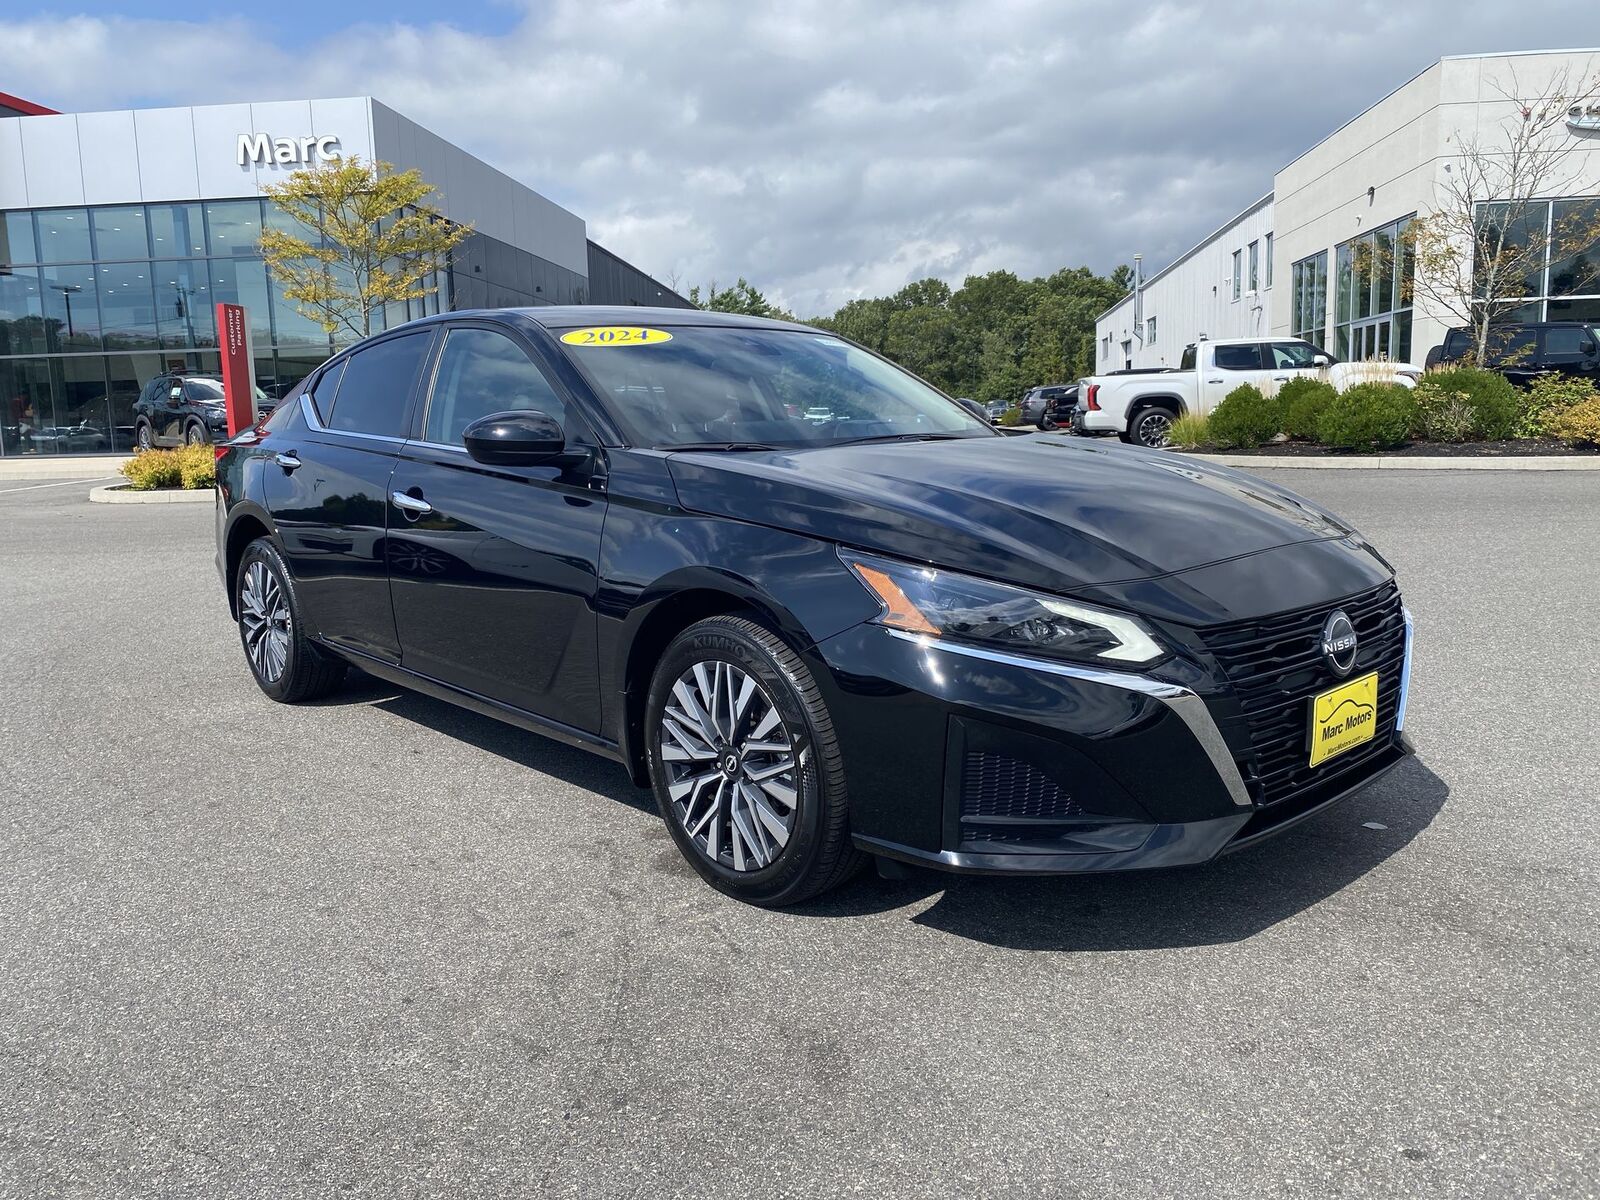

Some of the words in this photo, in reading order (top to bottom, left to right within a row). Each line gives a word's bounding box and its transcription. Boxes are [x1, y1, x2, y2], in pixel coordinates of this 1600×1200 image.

[236, 132, 339, 166] Marc
[228, 308, 236, 356] Customer
[581, 329, 649, 344] 2024
[1324, 635, 1355, 653] NISSA
[1321, 723, 1343, 742] Marc
[1345, 710, 1372, 731] Motors
